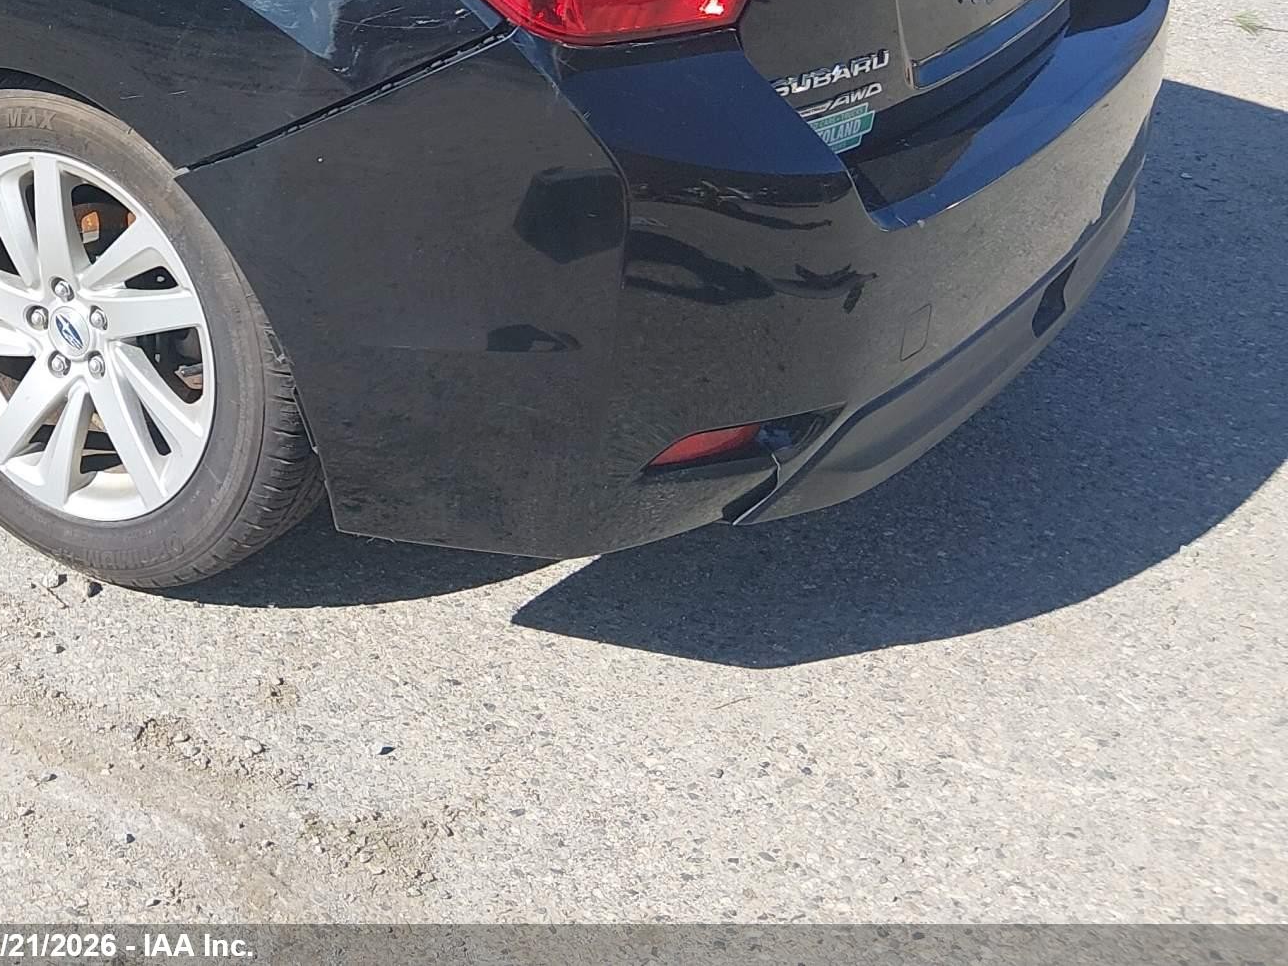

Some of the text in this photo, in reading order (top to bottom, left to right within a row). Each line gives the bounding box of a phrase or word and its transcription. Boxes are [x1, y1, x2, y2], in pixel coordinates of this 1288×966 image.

[772, 49, 890, 97] SUBARU
[829, 82, 883, 111] AWD
[2, 106, 58, 132] MAX
